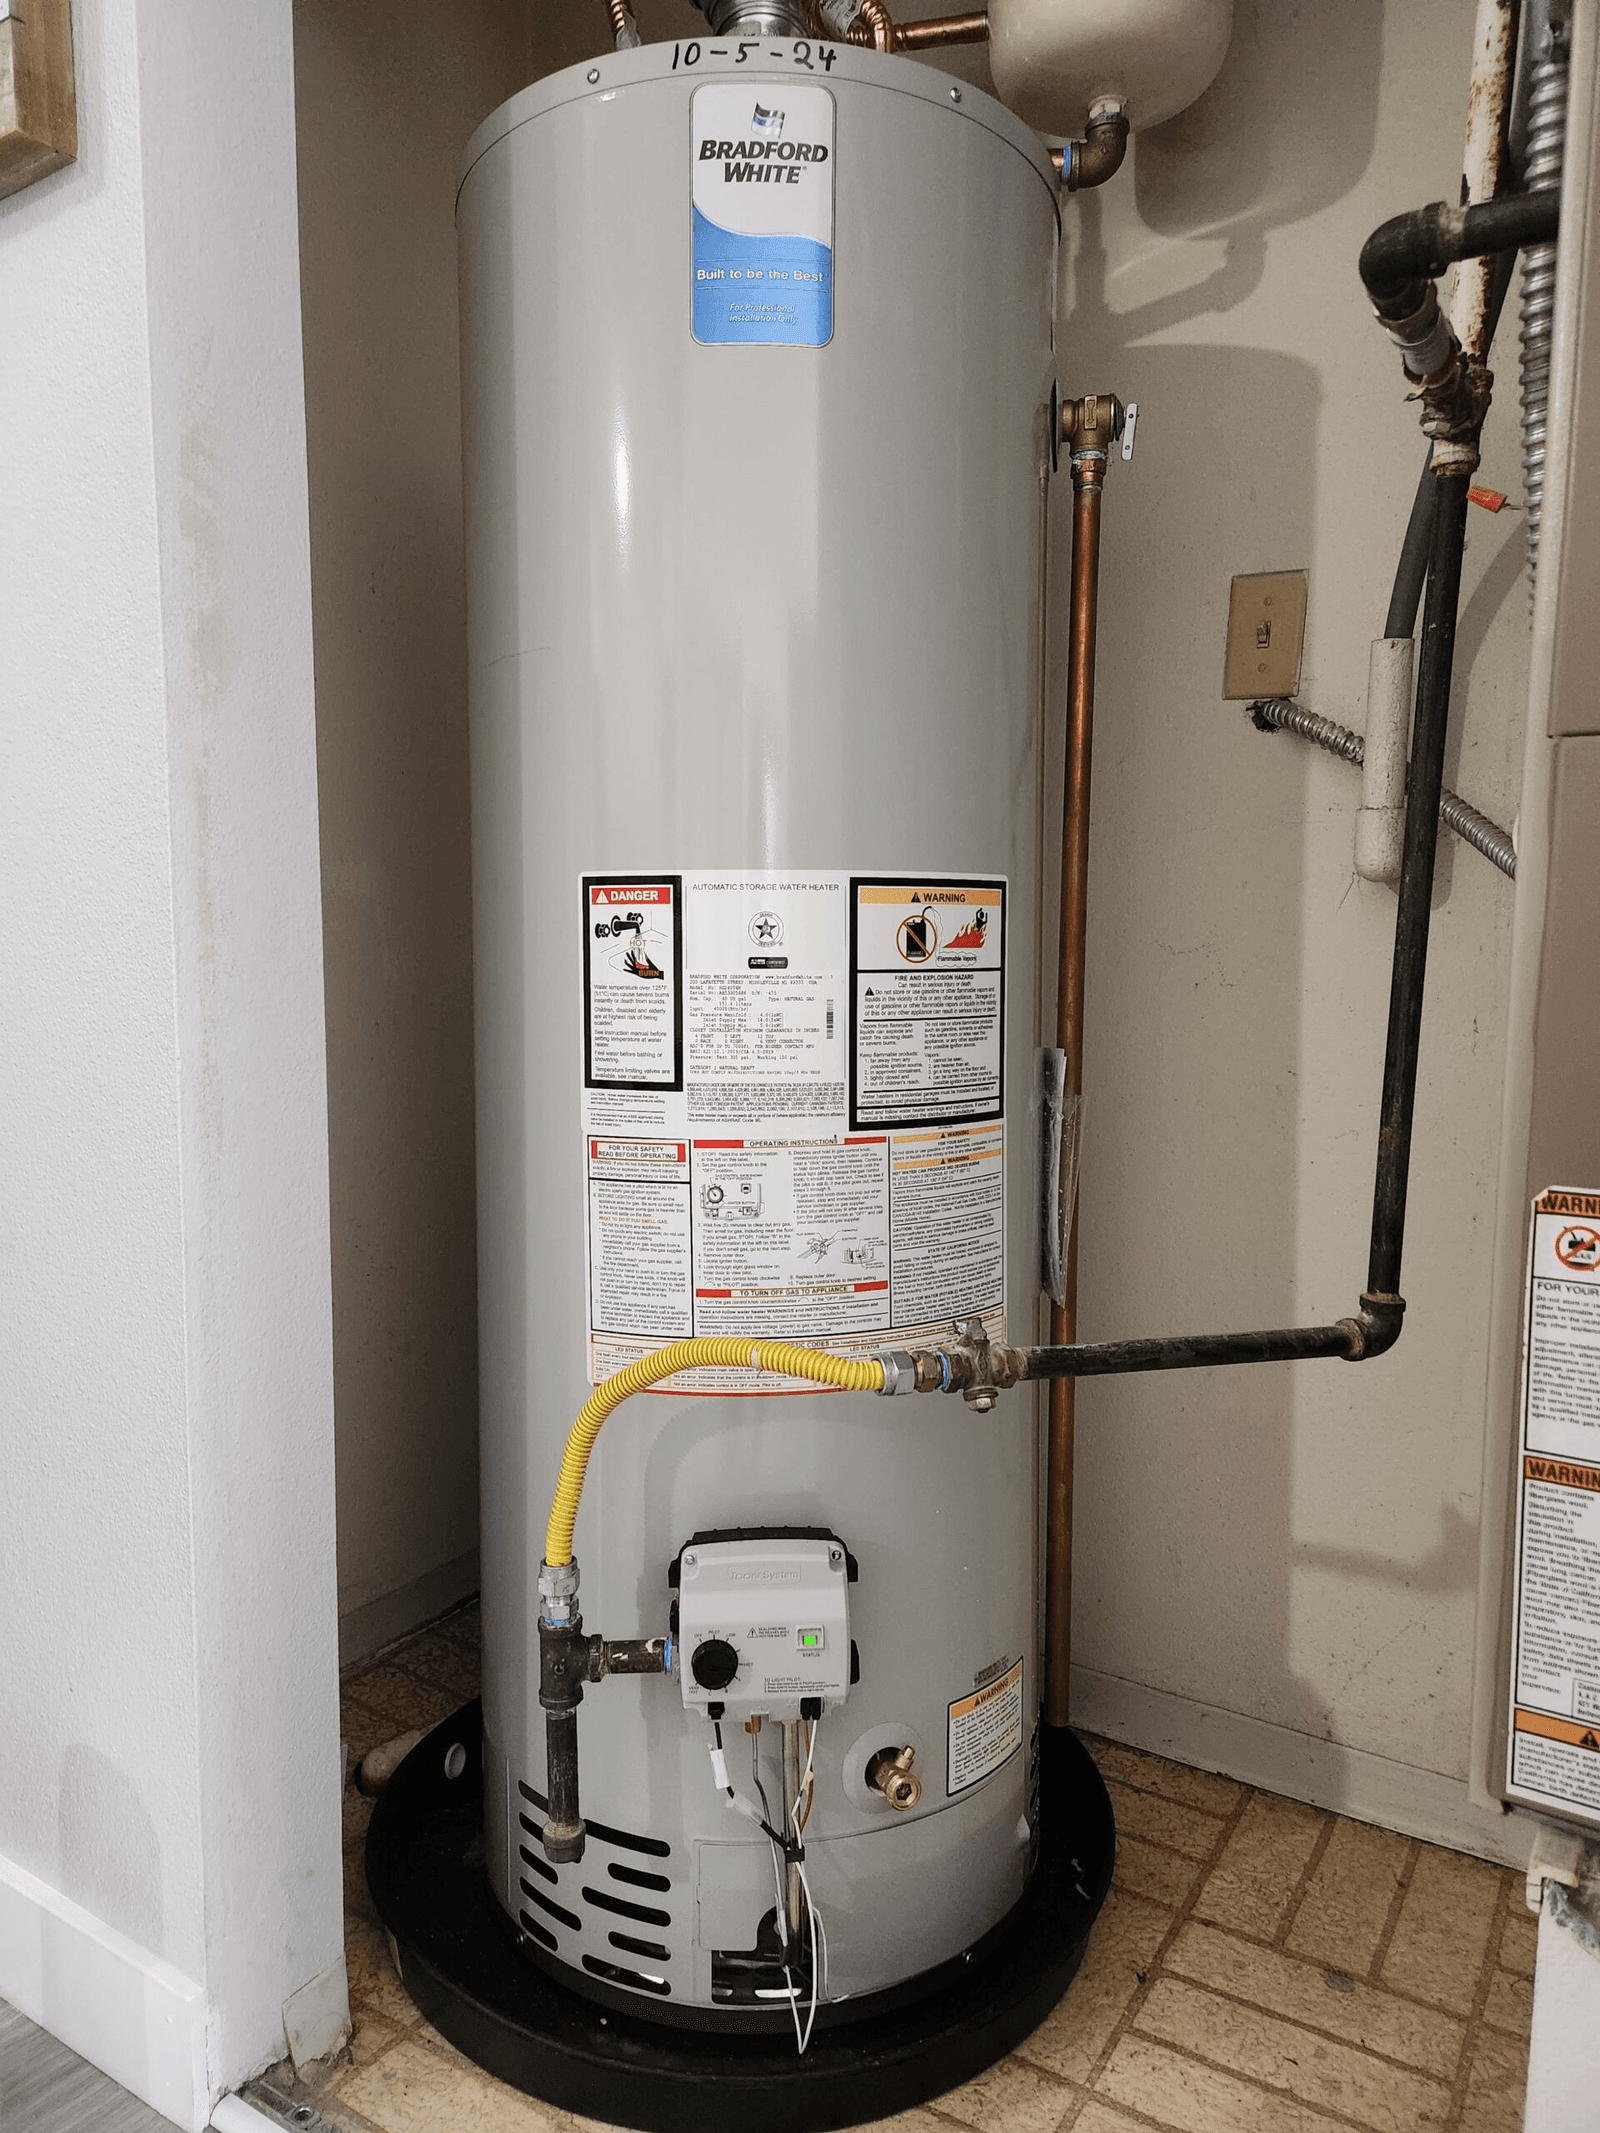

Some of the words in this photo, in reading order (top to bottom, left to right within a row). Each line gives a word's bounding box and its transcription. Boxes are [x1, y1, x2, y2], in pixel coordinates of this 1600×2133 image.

[698, 139, 828, 163] BRADFORD
[697, 269, 725, 281] Built
[729, 269, 742, 280] to
[746, 268, 763, 280] be
[768, 269, 789, 280] the
[793, 270, 824, 282] Best
[729, 303, 743, 313] For
[729, 313, 777, 323] Installation
[778, 314, 798, 325] Only
[610, 890, 658, 901] DANGER
[923, 893, 966, 902] WARNING
[629, 939, 647, 947] HOT
[1542, 1194, 1600, 1215] WARN
[1537, 1282, 1561, 1292] FOR
[1565, 1285, 1600, 1296] YOUR
[980, 1678, 1009, 1703] WARNING
